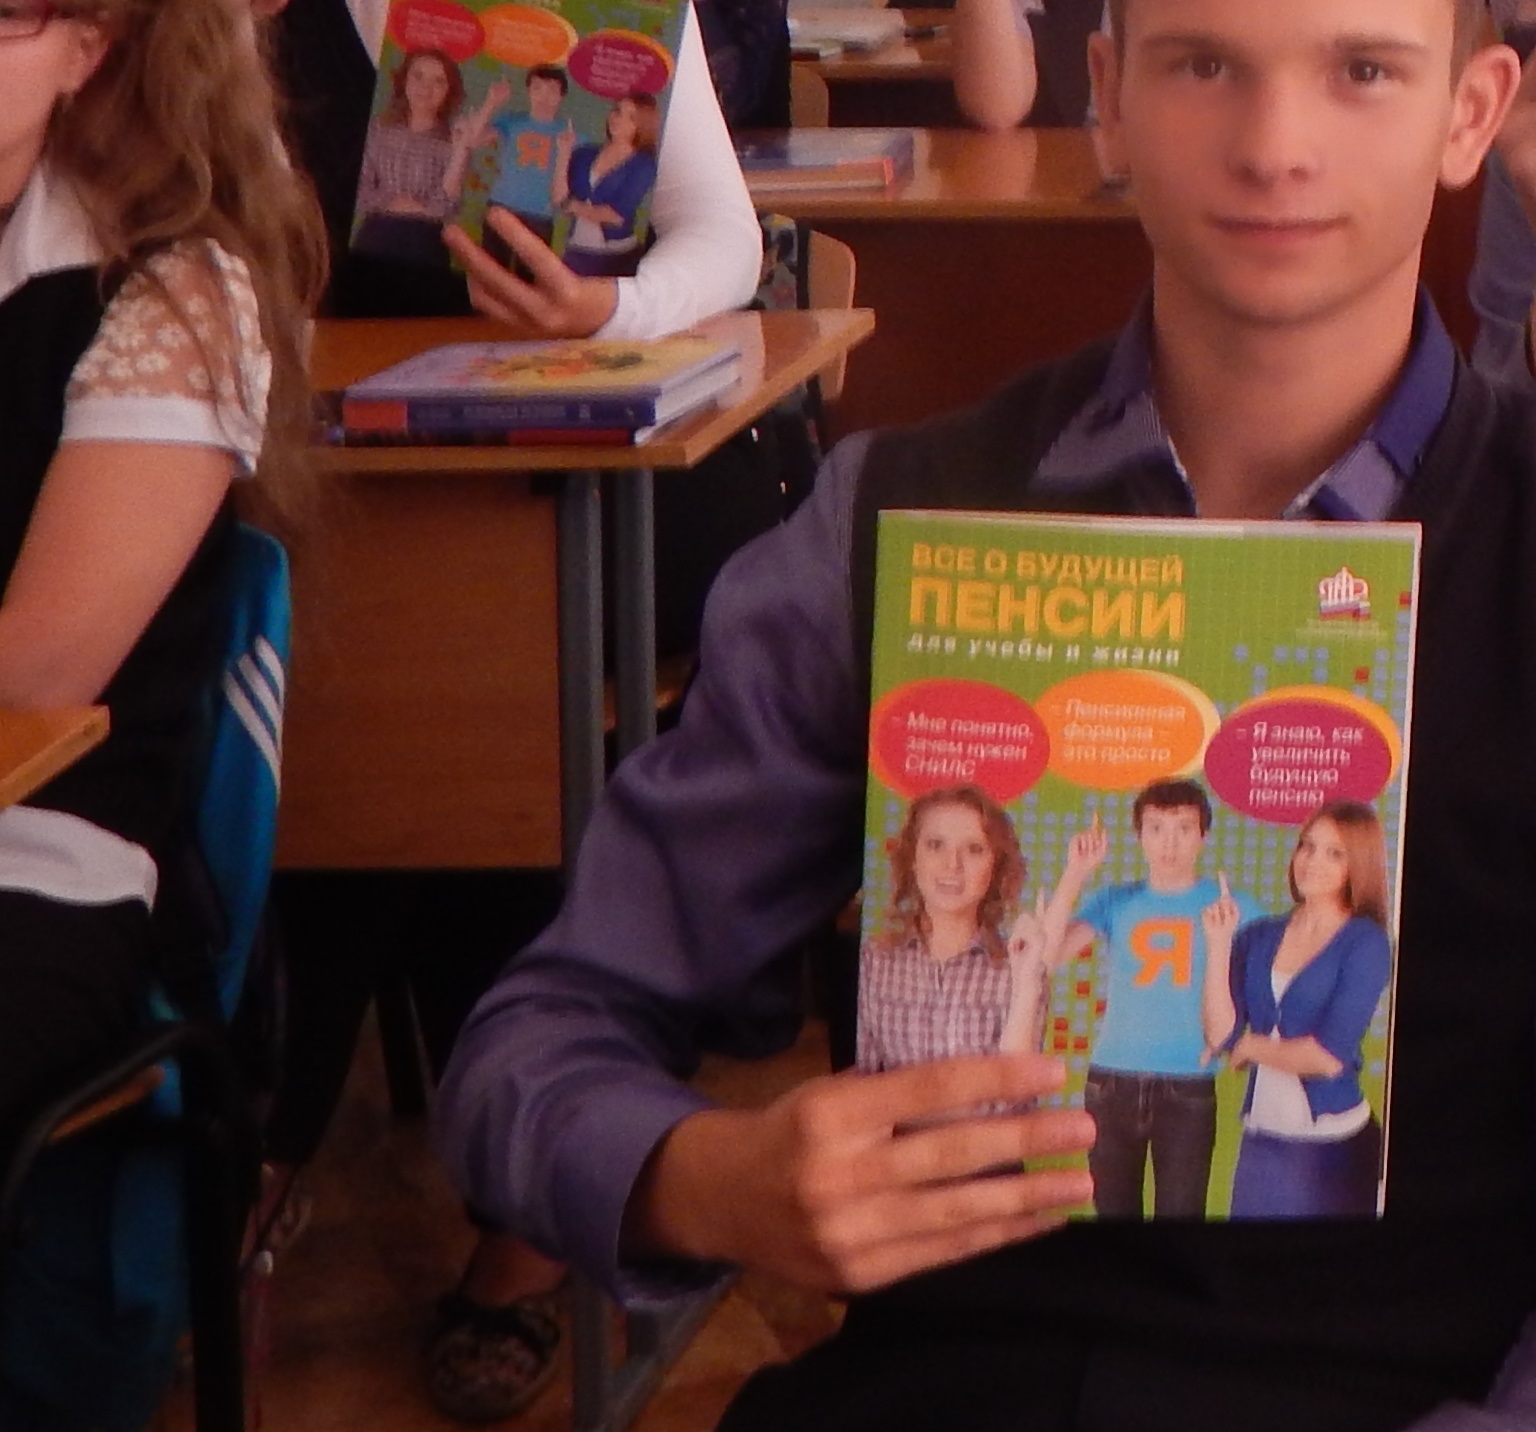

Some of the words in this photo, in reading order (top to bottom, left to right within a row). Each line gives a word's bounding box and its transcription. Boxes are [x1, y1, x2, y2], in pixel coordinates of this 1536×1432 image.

[517, 131, 550, 168] Я
[912, 542, 976, 573] ВСЕ
[984, 548, 1007, 574] О
[1017, 550, 1184, 587] БУДУЩЕЙ
[910, 576, 1186, 641] ПЕНСИИ
[907, 632, 956, 655] для
[969, 637, 1052, 661] учебы
[1066, 644, 1080, 662] и
[1093, 645, 1180, 666] жизни
[907, 711, 947, 732] Мне
[1253, 722, 1267, 742] Я
[1332, 726, 1363, 742] как
[907, 736, 962, 756] зачем
[967, 741, 1027, 761] нужен
[1251, 745, 1351, 764] увеличить
[905, 755, 976, 779] СНИЛС
[1250, 763, 1339, 786] будущую
[1249, 787, 1325, 807] пенсию
[1130, 916, 1194, 988] Я
